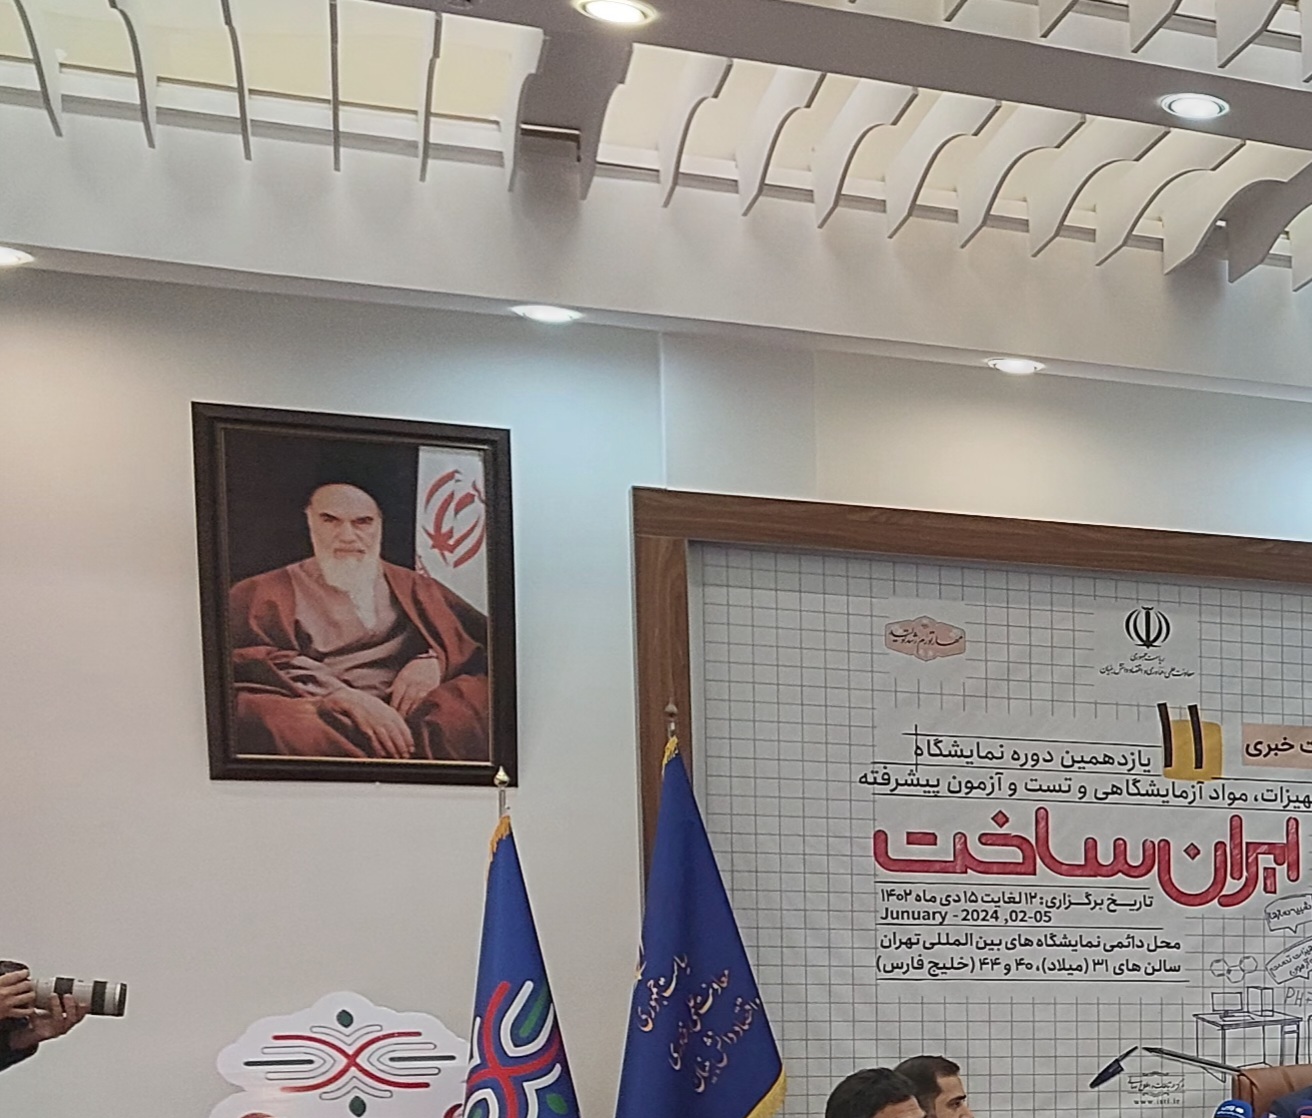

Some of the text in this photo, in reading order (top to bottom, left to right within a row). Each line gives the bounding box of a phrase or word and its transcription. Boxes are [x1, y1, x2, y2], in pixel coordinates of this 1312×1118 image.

[914, 738, 1151, 771] یازدهمین دوره نمایشگاه
[1245, 736, 1295, 757] خبری
[858, 770, 940, 794] پیشرفته
[947, 771, 1004, 796] آزمون
[1008, 781, 1018, 797] و
[1023, 778, 1073, 795] تست
[1094, 778, 1203, 803] آزمایشگاهی
[1077, 786, 1087, 800] و
[1208, 783, 1248, 804] مواد
[915, 889, 938, 904] ماه
[940, 890, 962, 906] دی
[981, 890, 1022, 907] لغایت
[1107, 894, 1153, 912] تاریخ
[880, 906, 949, 925] Junuary
[880, 931, 921, 950] تهران
[922, 932, 974, 950] المللی
[975, 935, 1002, 950] بین
[1005, 933, 1034, 950] های
[1036, 932, 1100, 950] نمایشگاه
[1147, 938, 1181, 951] محل
[1112, 959, 1141, 974] های
[1145, 959, 1181, 976] سالن
